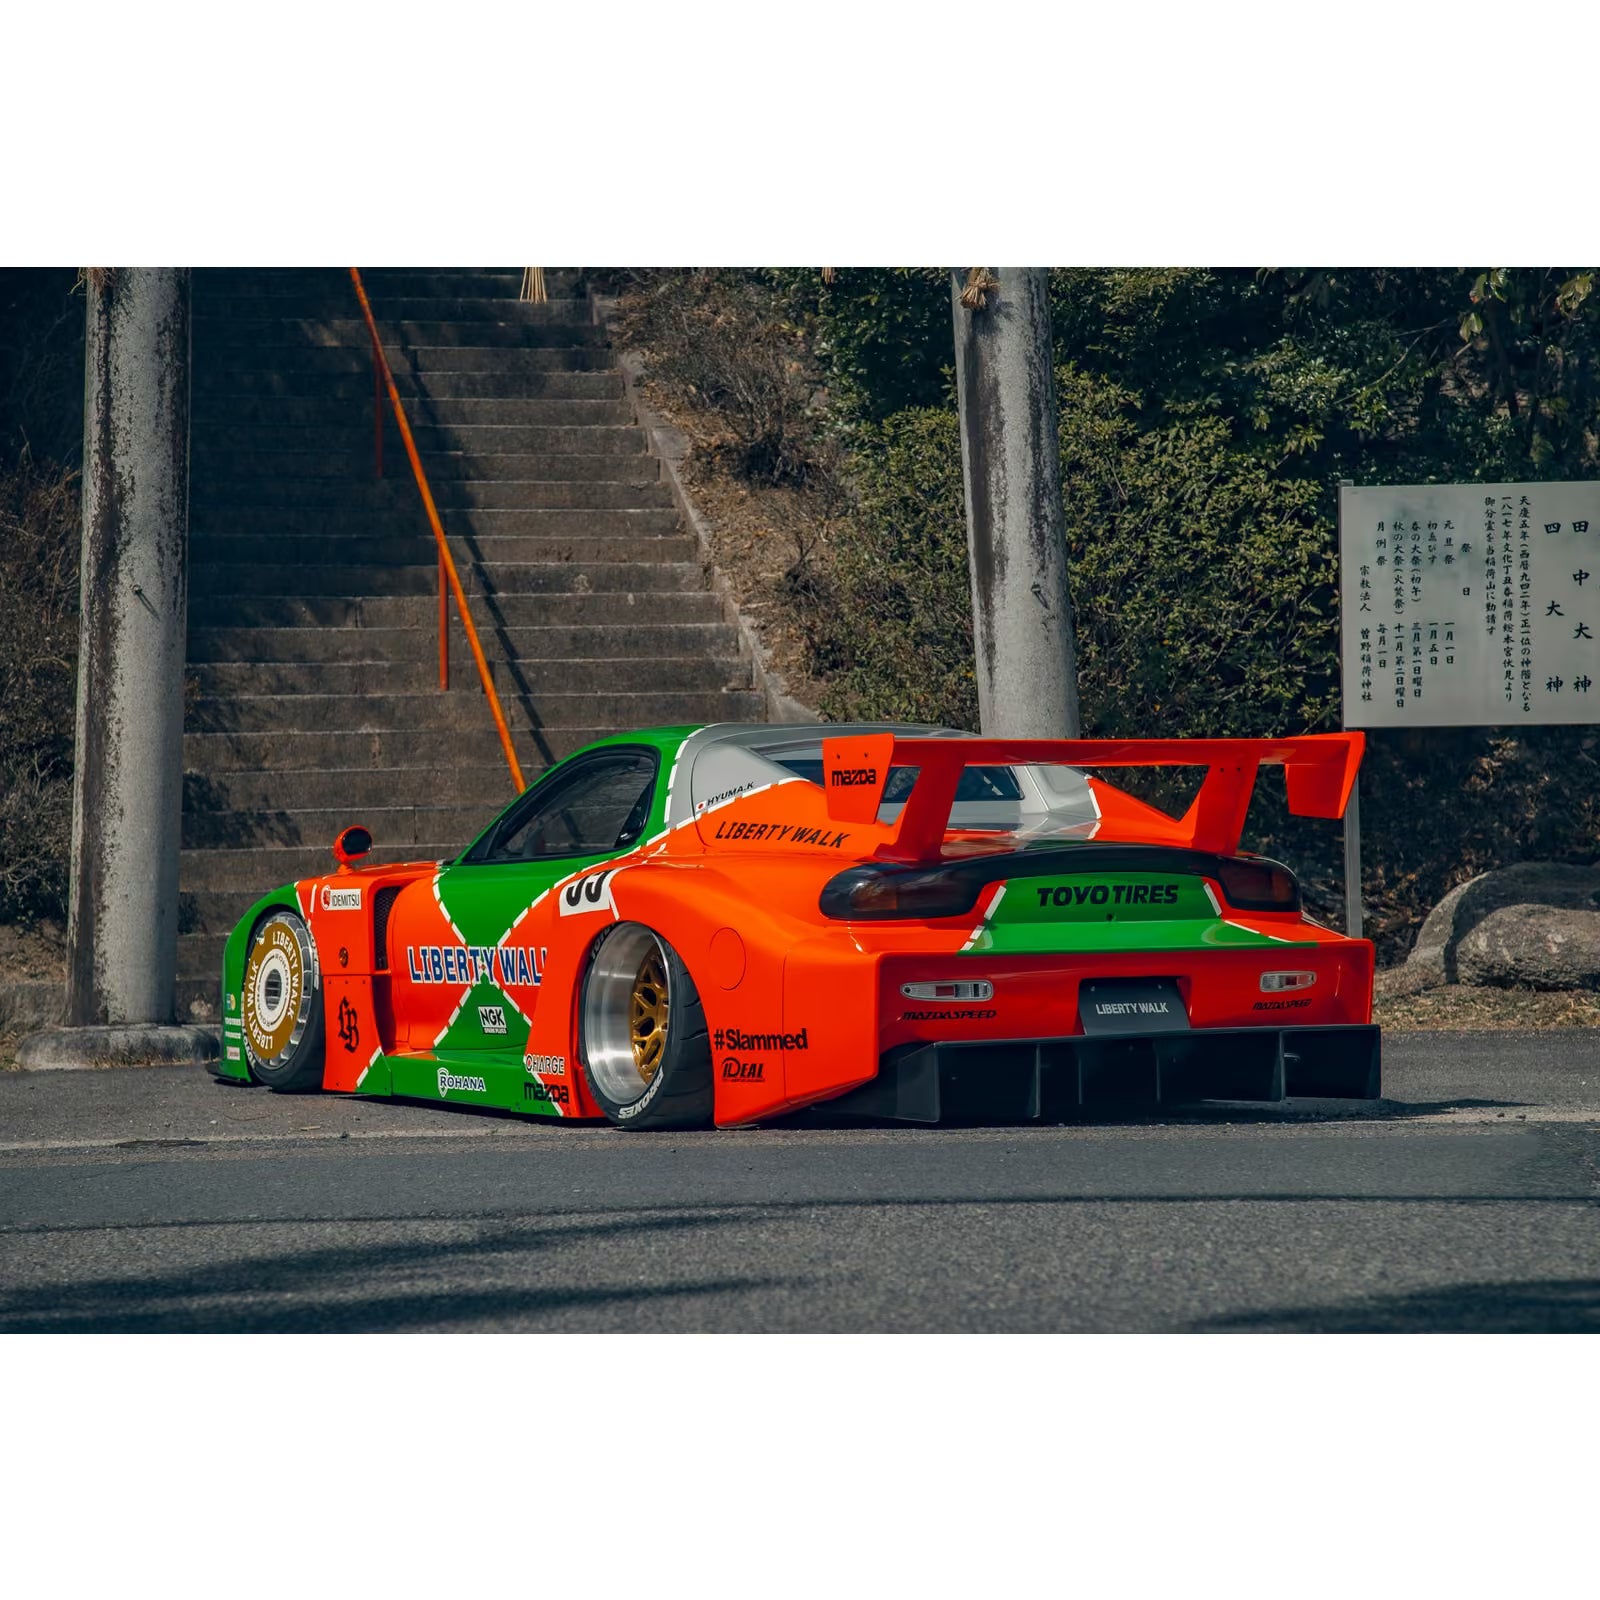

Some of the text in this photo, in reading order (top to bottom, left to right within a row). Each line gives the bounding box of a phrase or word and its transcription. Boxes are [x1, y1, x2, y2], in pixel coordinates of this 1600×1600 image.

[1376, 521, 1387, 566] 月例祭
[1544, 522, 1565, 693] 四大神
[1572, 520, 1593, 693] 田中大神
[1428, 622, 1439, 665] 一月五日
[1444, 622, 1455, 664] 一月一日
[832, 769, 876, 786] mazda
[707, 781, 754, 806] HYUMA.K
[715, 821, 850, 848] LIBERTY WALK
[332, 894, 360, 907] IDEMITSU
[1037, 884, 1179, 907] TOYO TIRES
[272, 931, 299, 1021] LIBERTY WALK
[407, 946, 496, 984] LIBERTY
[247, 960, 273, 1049] LIBERTY WALK
[481, 1008, 505, 1026] NGK
[1096, 1002, 1168, 1015] LIBERTY WALK
[714, 1028, 808, 1050] #Slammed
[526, 1055, 564, 1075] CHARGE
[439, 1075, 486, 1091] ROHANA
[524, 1082, 569, 1103] mazda
[618, 1065, 664, 1119] PROXES
